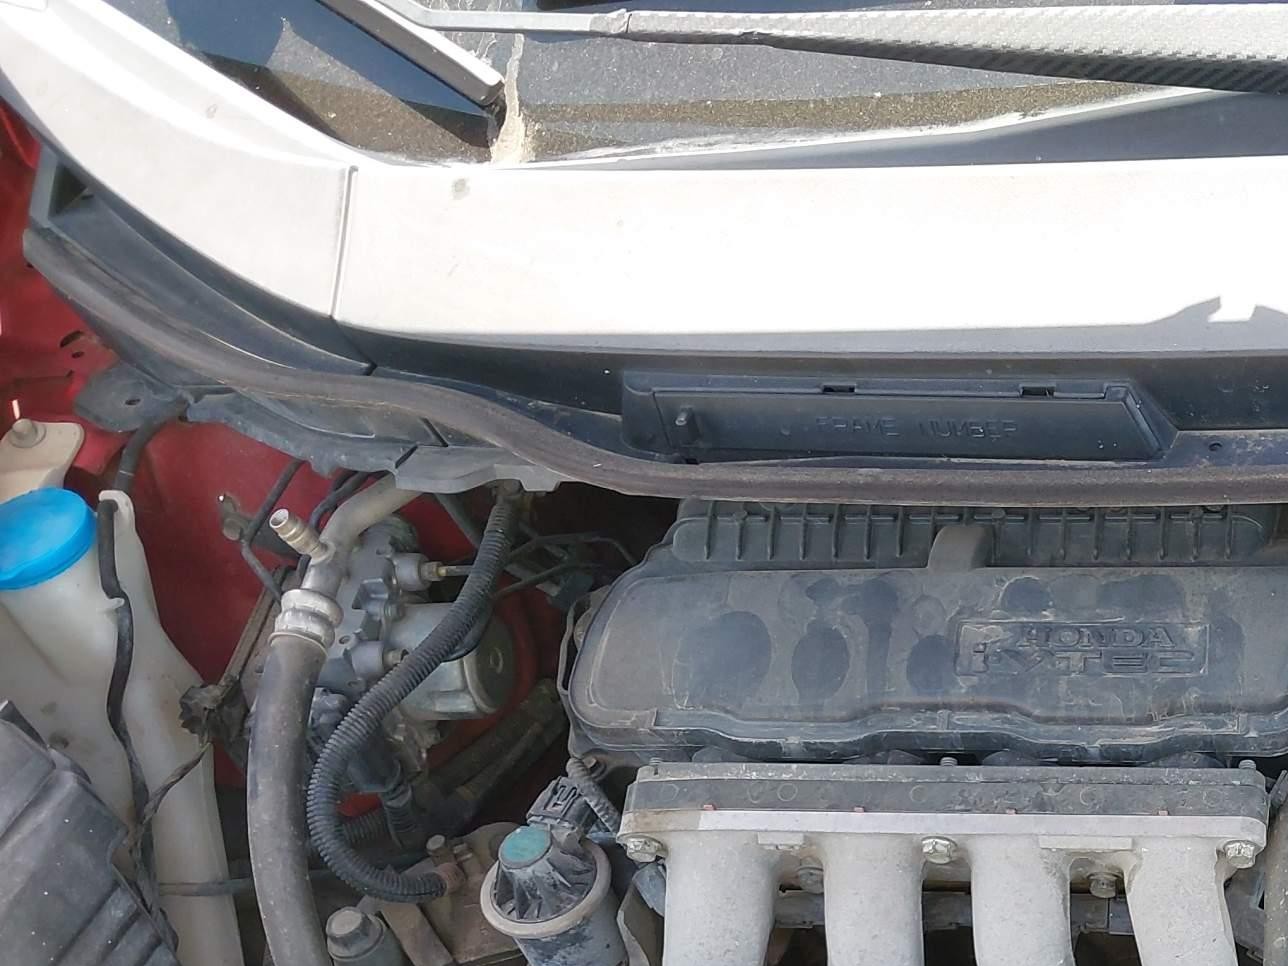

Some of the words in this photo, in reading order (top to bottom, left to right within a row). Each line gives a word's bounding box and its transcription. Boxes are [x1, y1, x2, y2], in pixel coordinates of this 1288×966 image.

[816, 415, 900, 436] FRAME
[919, 418, 1018, 438] NUMBER
[1016, 625, 1176, 649] HONDA
